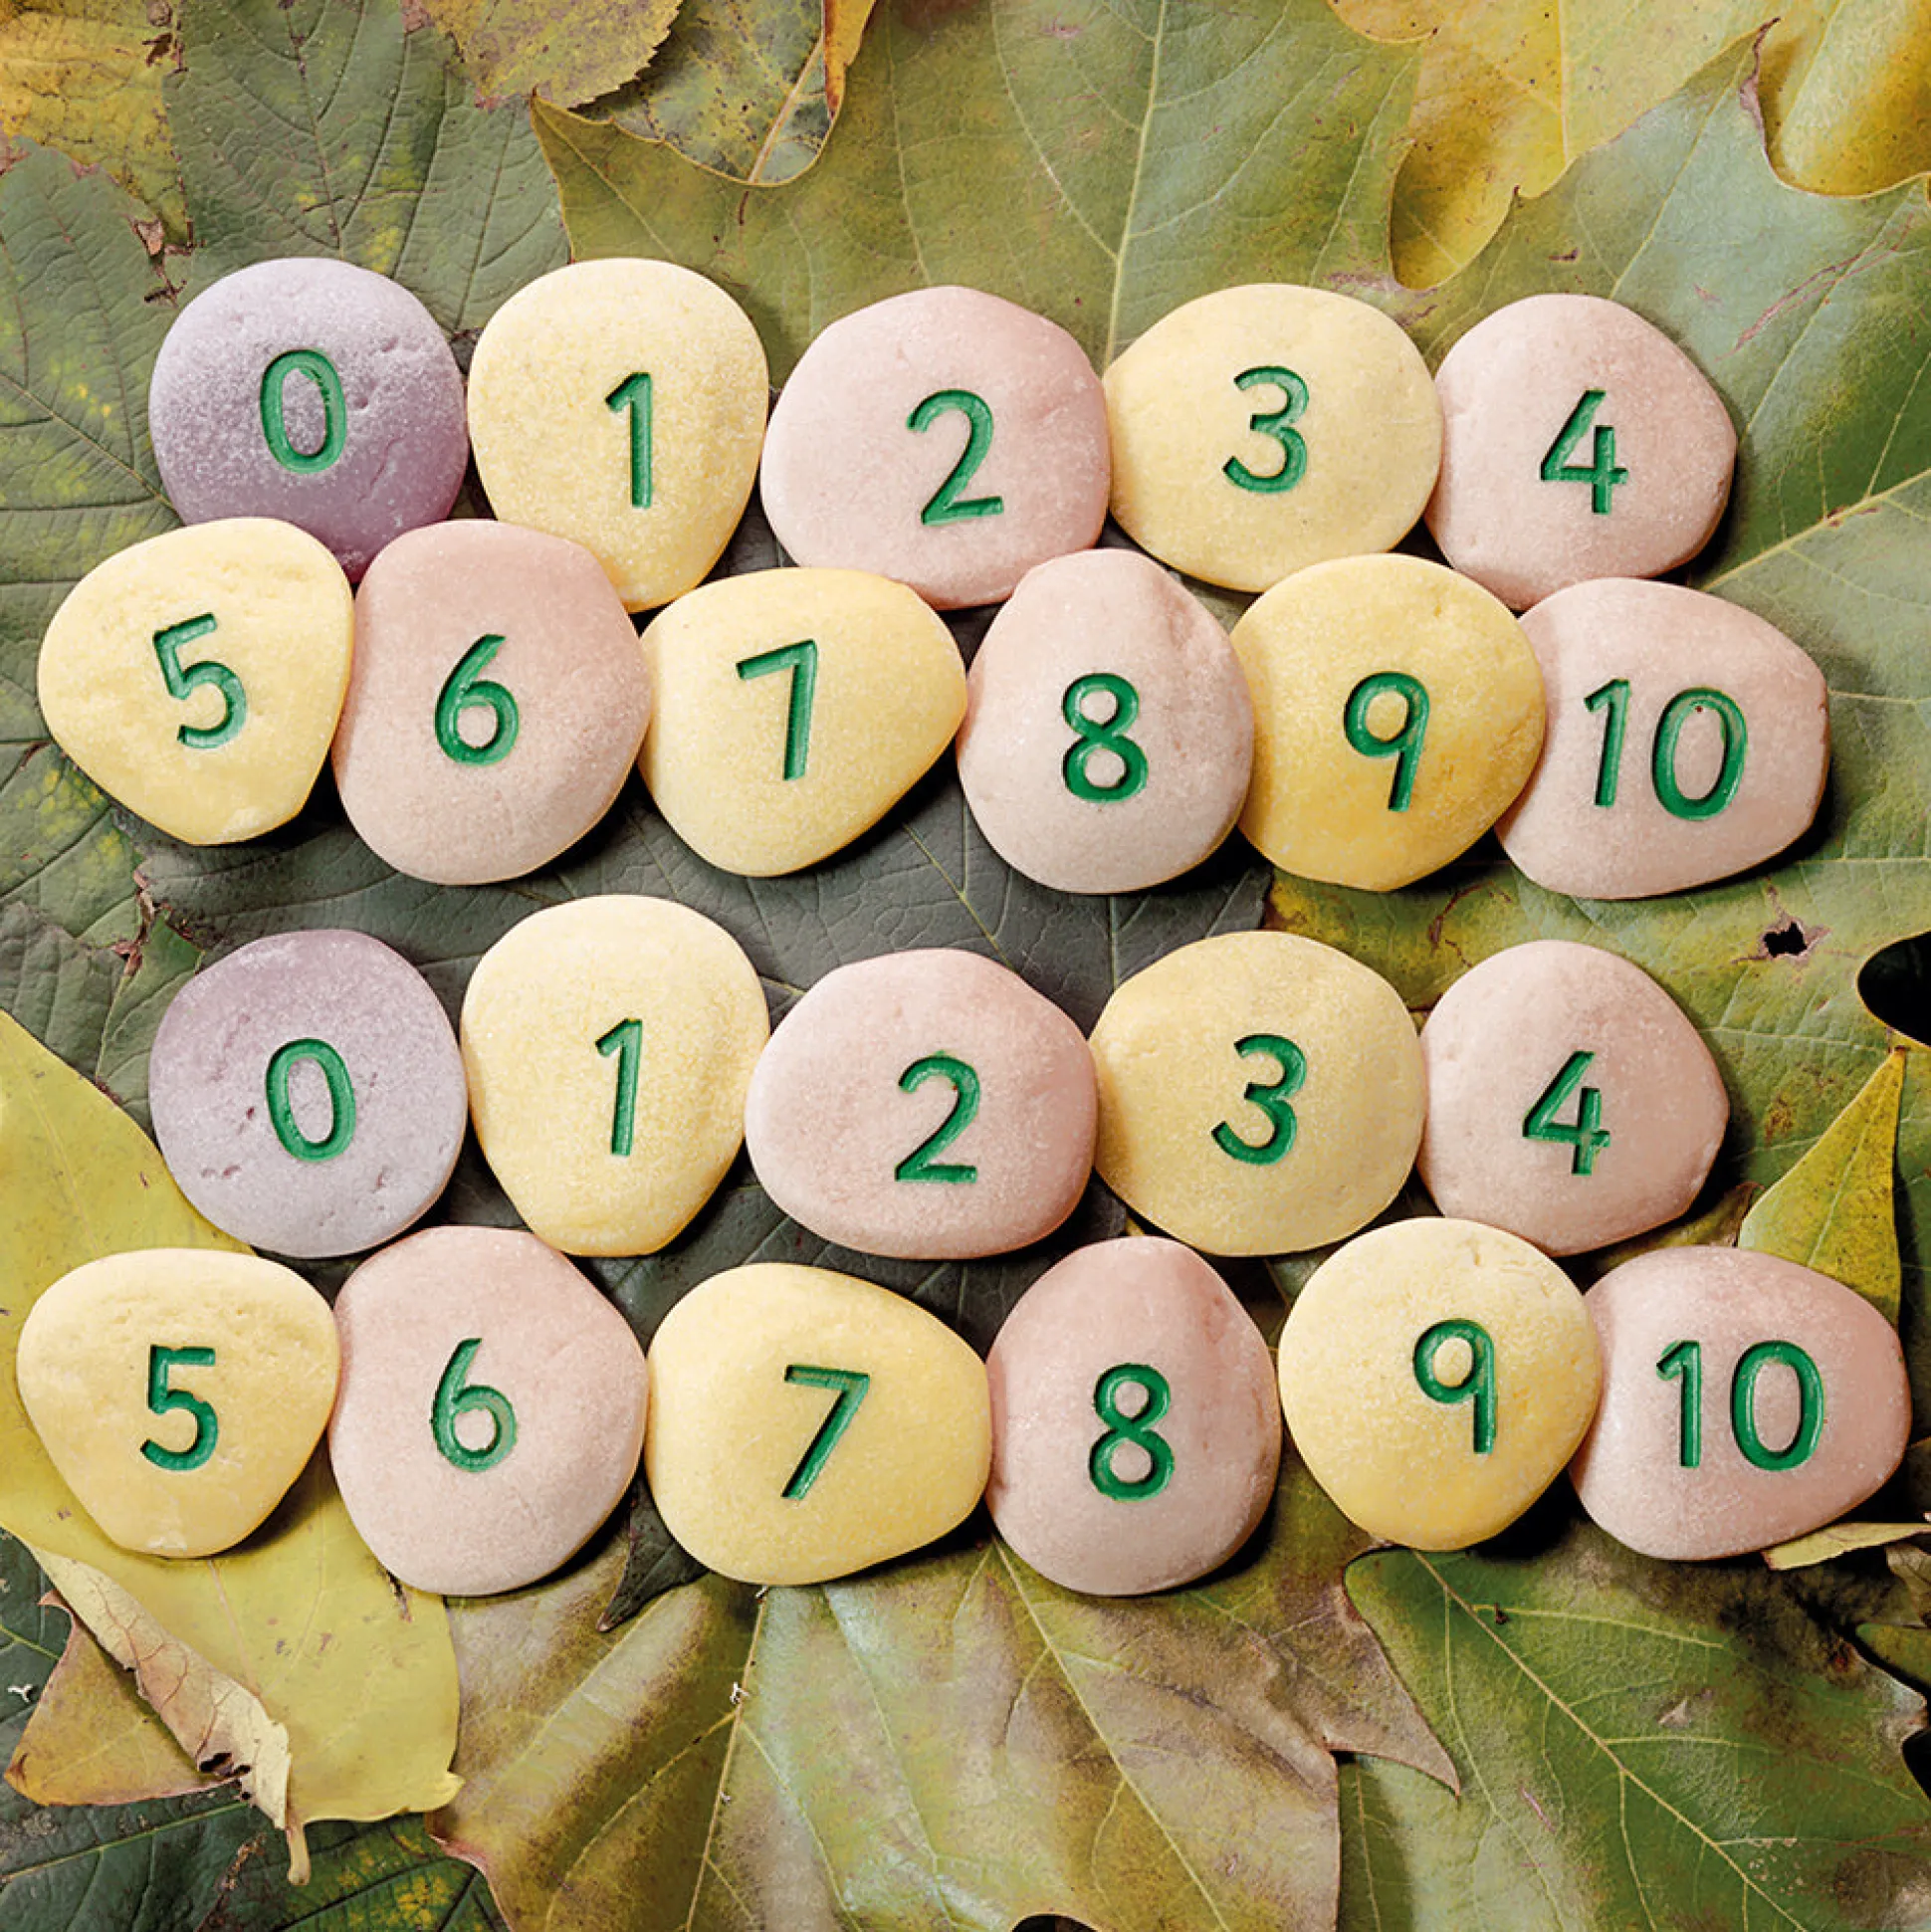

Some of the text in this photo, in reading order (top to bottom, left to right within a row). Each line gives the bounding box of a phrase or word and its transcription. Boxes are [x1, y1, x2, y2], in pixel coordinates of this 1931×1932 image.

[260, 350, 346, 473] 0
[608, 374, 653, 508] 1
[907, 390, 1003, 525] 2
[1225, 367, 1309, 494] 3
[1542, 392, 1628, 515] 4
[154, 614, 245, 749] 5
[435, 635, 519, 765] 6
[738, 641, 817, 780] 7
[1063, 674, 1148, 803] 8
[1346, 673, 1429, 811] 9
[1585, 681, 1747, 820] 10
[266, 1039, 355, 1162] 0
[597, 1021, 642, 1156] 1
[897, 1051, 979, 1183] 2
[1214, 1035, 1306, 1165] 3
[1524, 1051, 1610, 1176] 4
[142, 1347, 218, 1470] 5
[431, 1340, 516, 1472] 6
[783, 1367, 870, 1499] 7
[1090, 1364, 1175, 1501] 8
[1414, 1321, 1495, 1453] 9
[1657, 1342, 1824, 1471] 10
